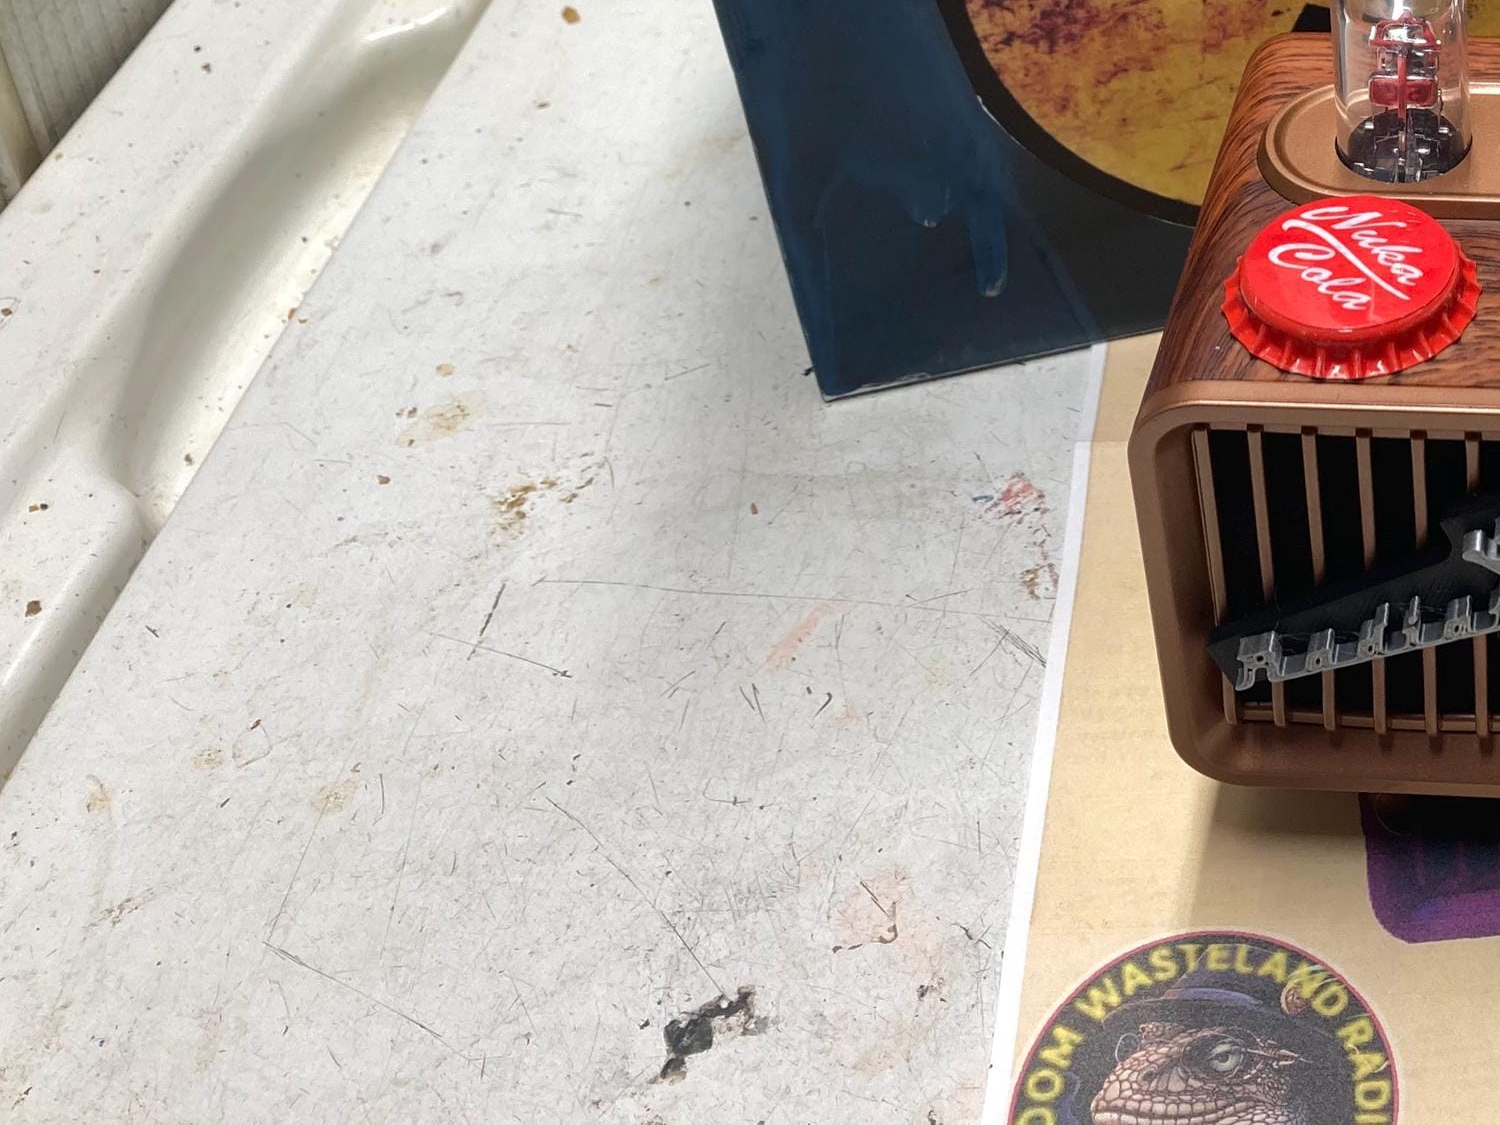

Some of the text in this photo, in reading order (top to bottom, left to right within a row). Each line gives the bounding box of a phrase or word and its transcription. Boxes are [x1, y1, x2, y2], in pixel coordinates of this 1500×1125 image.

[1268, 243, 1372, 310] Cola
[1300, 206, 1424, 286] Nuka
[1073, 942, 1349, 1024] WASTELAND
